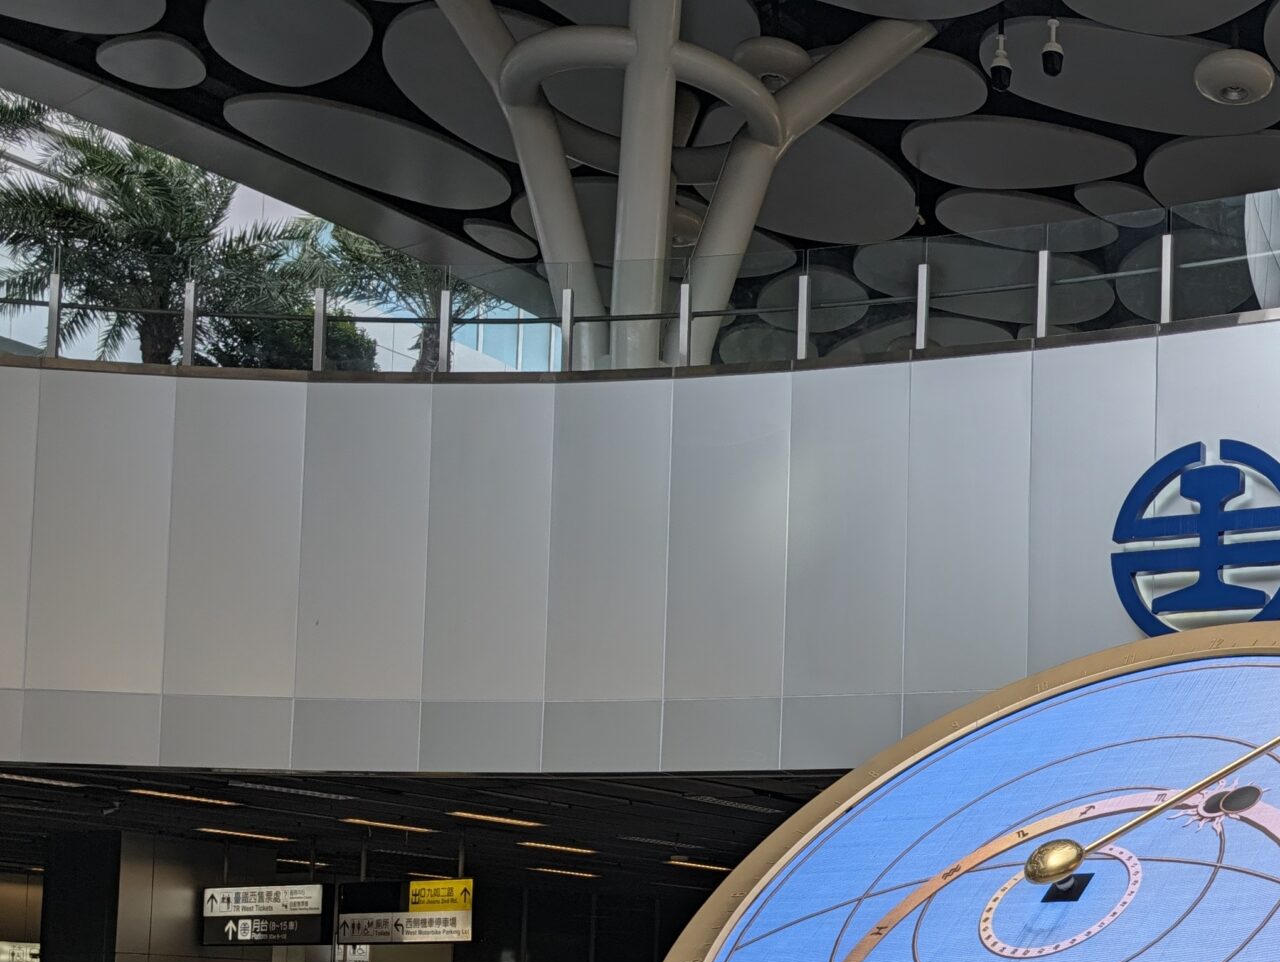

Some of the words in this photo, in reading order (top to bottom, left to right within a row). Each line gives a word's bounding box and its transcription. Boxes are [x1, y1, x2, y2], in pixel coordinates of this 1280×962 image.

[255, 904, 273, 912] Tickets
[252, 918, 269, 932] 月台
[442, 928, 461, 937] Parking
